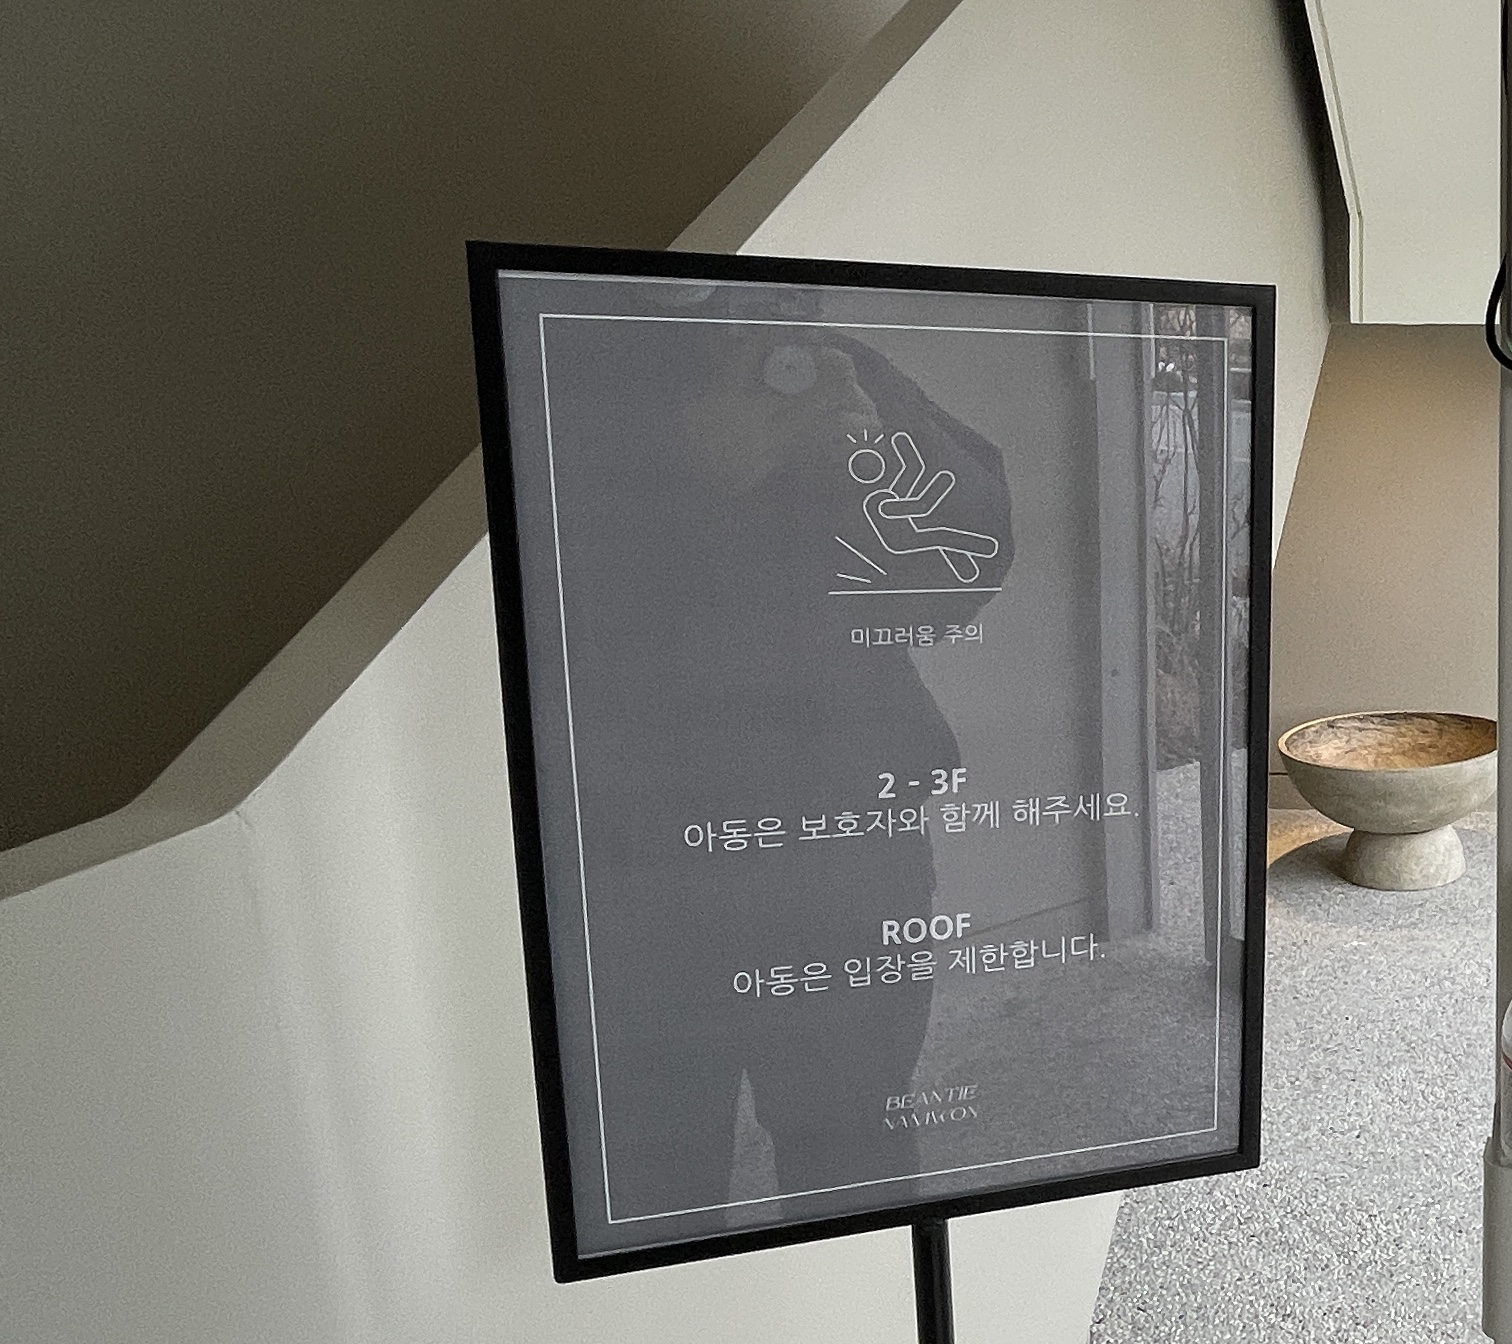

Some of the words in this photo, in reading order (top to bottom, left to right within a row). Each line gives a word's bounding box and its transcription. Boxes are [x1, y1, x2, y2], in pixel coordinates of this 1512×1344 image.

[850, 624, 938, 648] 미끄러움
[944, 623, 984, 644] 주의
[878, 773, 897, 800] 2
[931, 767, 967, 796] 3F
[683, 814, 787, 853] 아동은
[799, 805, 931, 841] 보호자와
[940, 800, 1001, 834] 함께
[1012, 790, 1140, 826] 해주세요.
[882, 912, 972, 946] ROOF
[732, 960, 833, 999] 아동은
[843, 952, 938, 988] 입장을
[949, 931, 1107, 976] 제한합니다.
